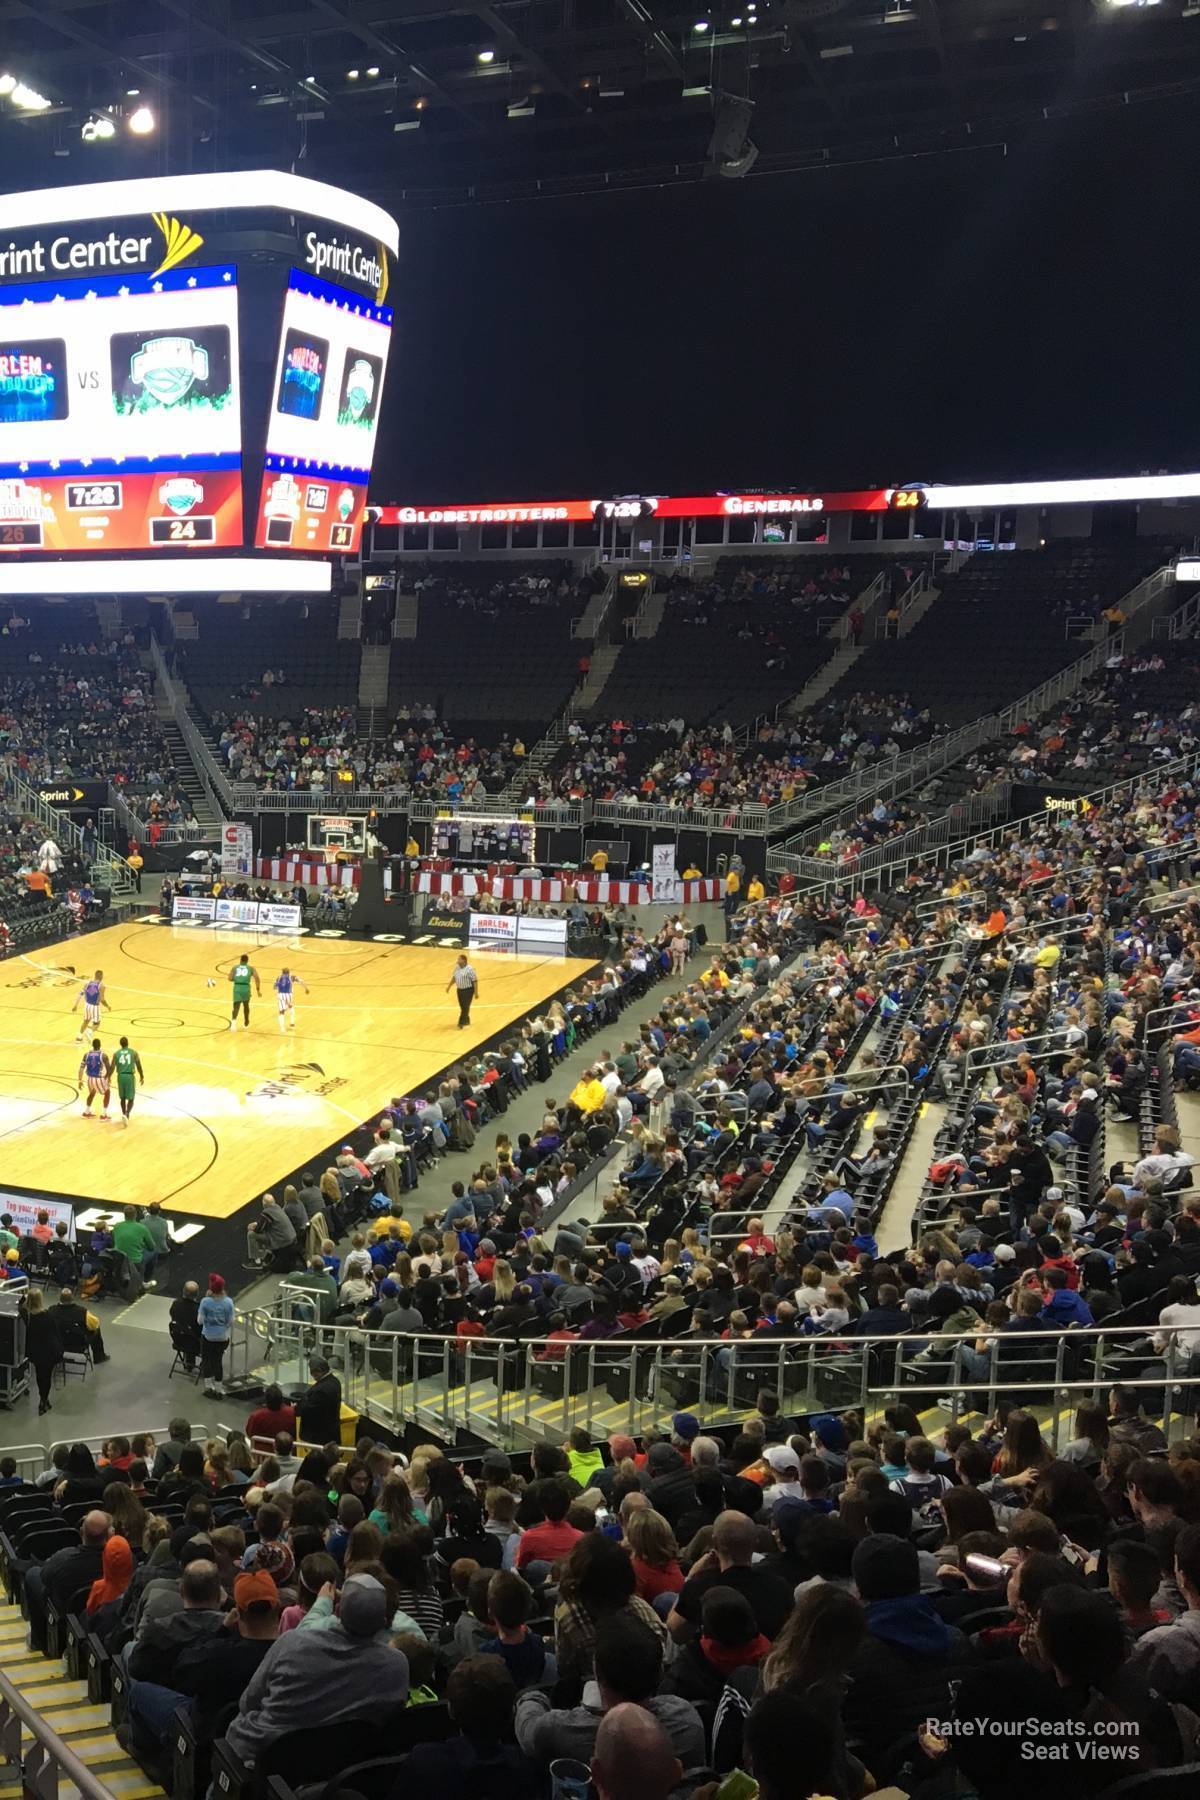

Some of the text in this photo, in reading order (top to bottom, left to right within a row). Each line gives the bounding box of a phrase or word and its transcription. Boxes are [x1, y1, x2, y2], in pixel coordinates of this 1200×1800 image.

[51, 232, 152, 270] Center
[306, 231, 383, 288] Sprint Center
[78, 370, 100, 389] VS
[73, 486, 115, 505] 7:26
[398, 492, 919, 523] GLOBETROTTERS 7:26 GENERALS 24
[3, 526, 25, 543] 26
[170, 520, 196, 539] 24
[40, 790, 69, 802] Sprint
[1045, 795, 1077, 812] Sprint
[477, 919, 509, 929] HARLEM
[118, 1054, 132, 1065] 41
[6, 1200, 17, 1212] Tag
